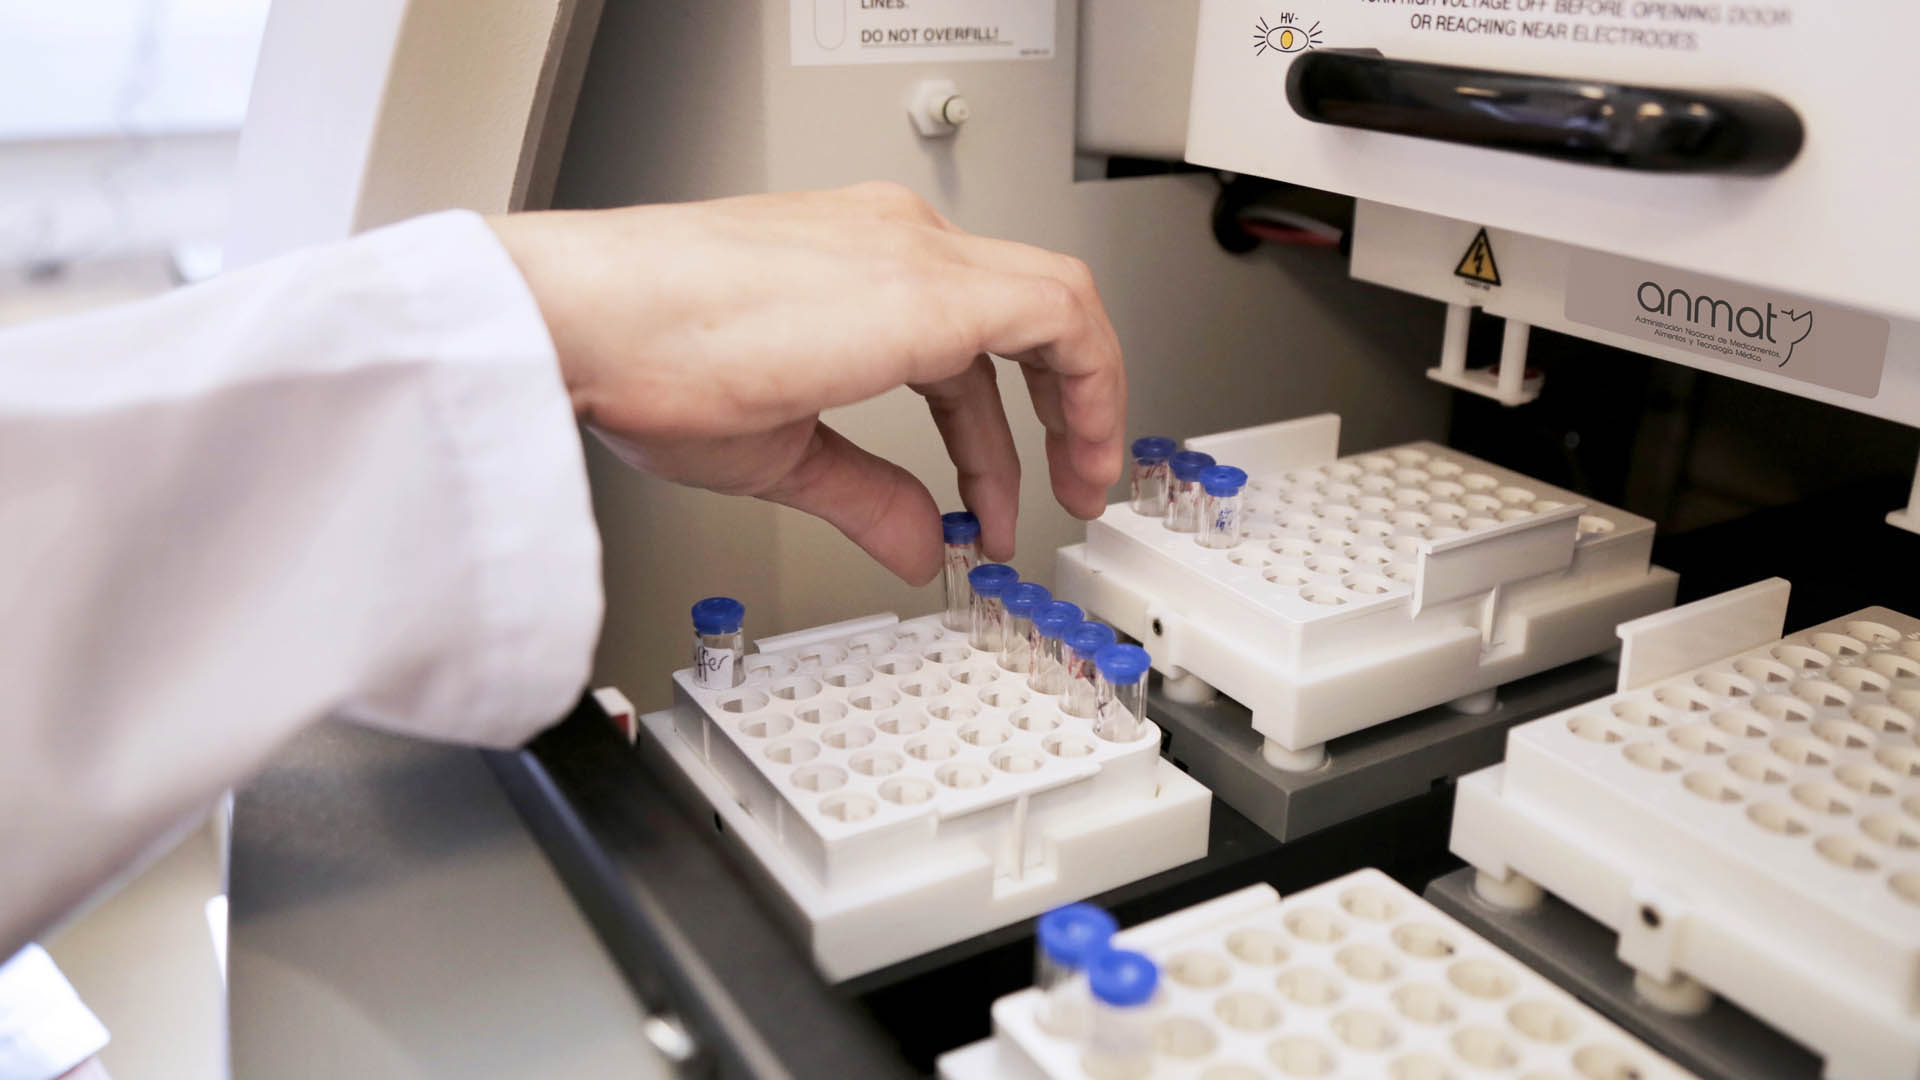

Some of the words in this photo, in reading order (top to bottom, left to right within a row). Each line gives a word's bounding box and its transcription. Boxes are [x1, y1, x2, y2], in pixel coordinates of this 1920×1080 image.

[861, 29, 884, 43] DO
[888, 28, 918, 42] NOT
[923, 27, 999, 42] OVERFILL!
[1411, 13, 1432, 30] OR
[1436, 15, 1517, 36] REACHING
[1522, 21, 1569, 40] NEAR
[1637, 281, 1777, 344] anmat
[1654, 328, 1687, 344] Alimentos
[1685, 327, 1715, 341] Nacional
[1717, 337, 1728, 345] de
